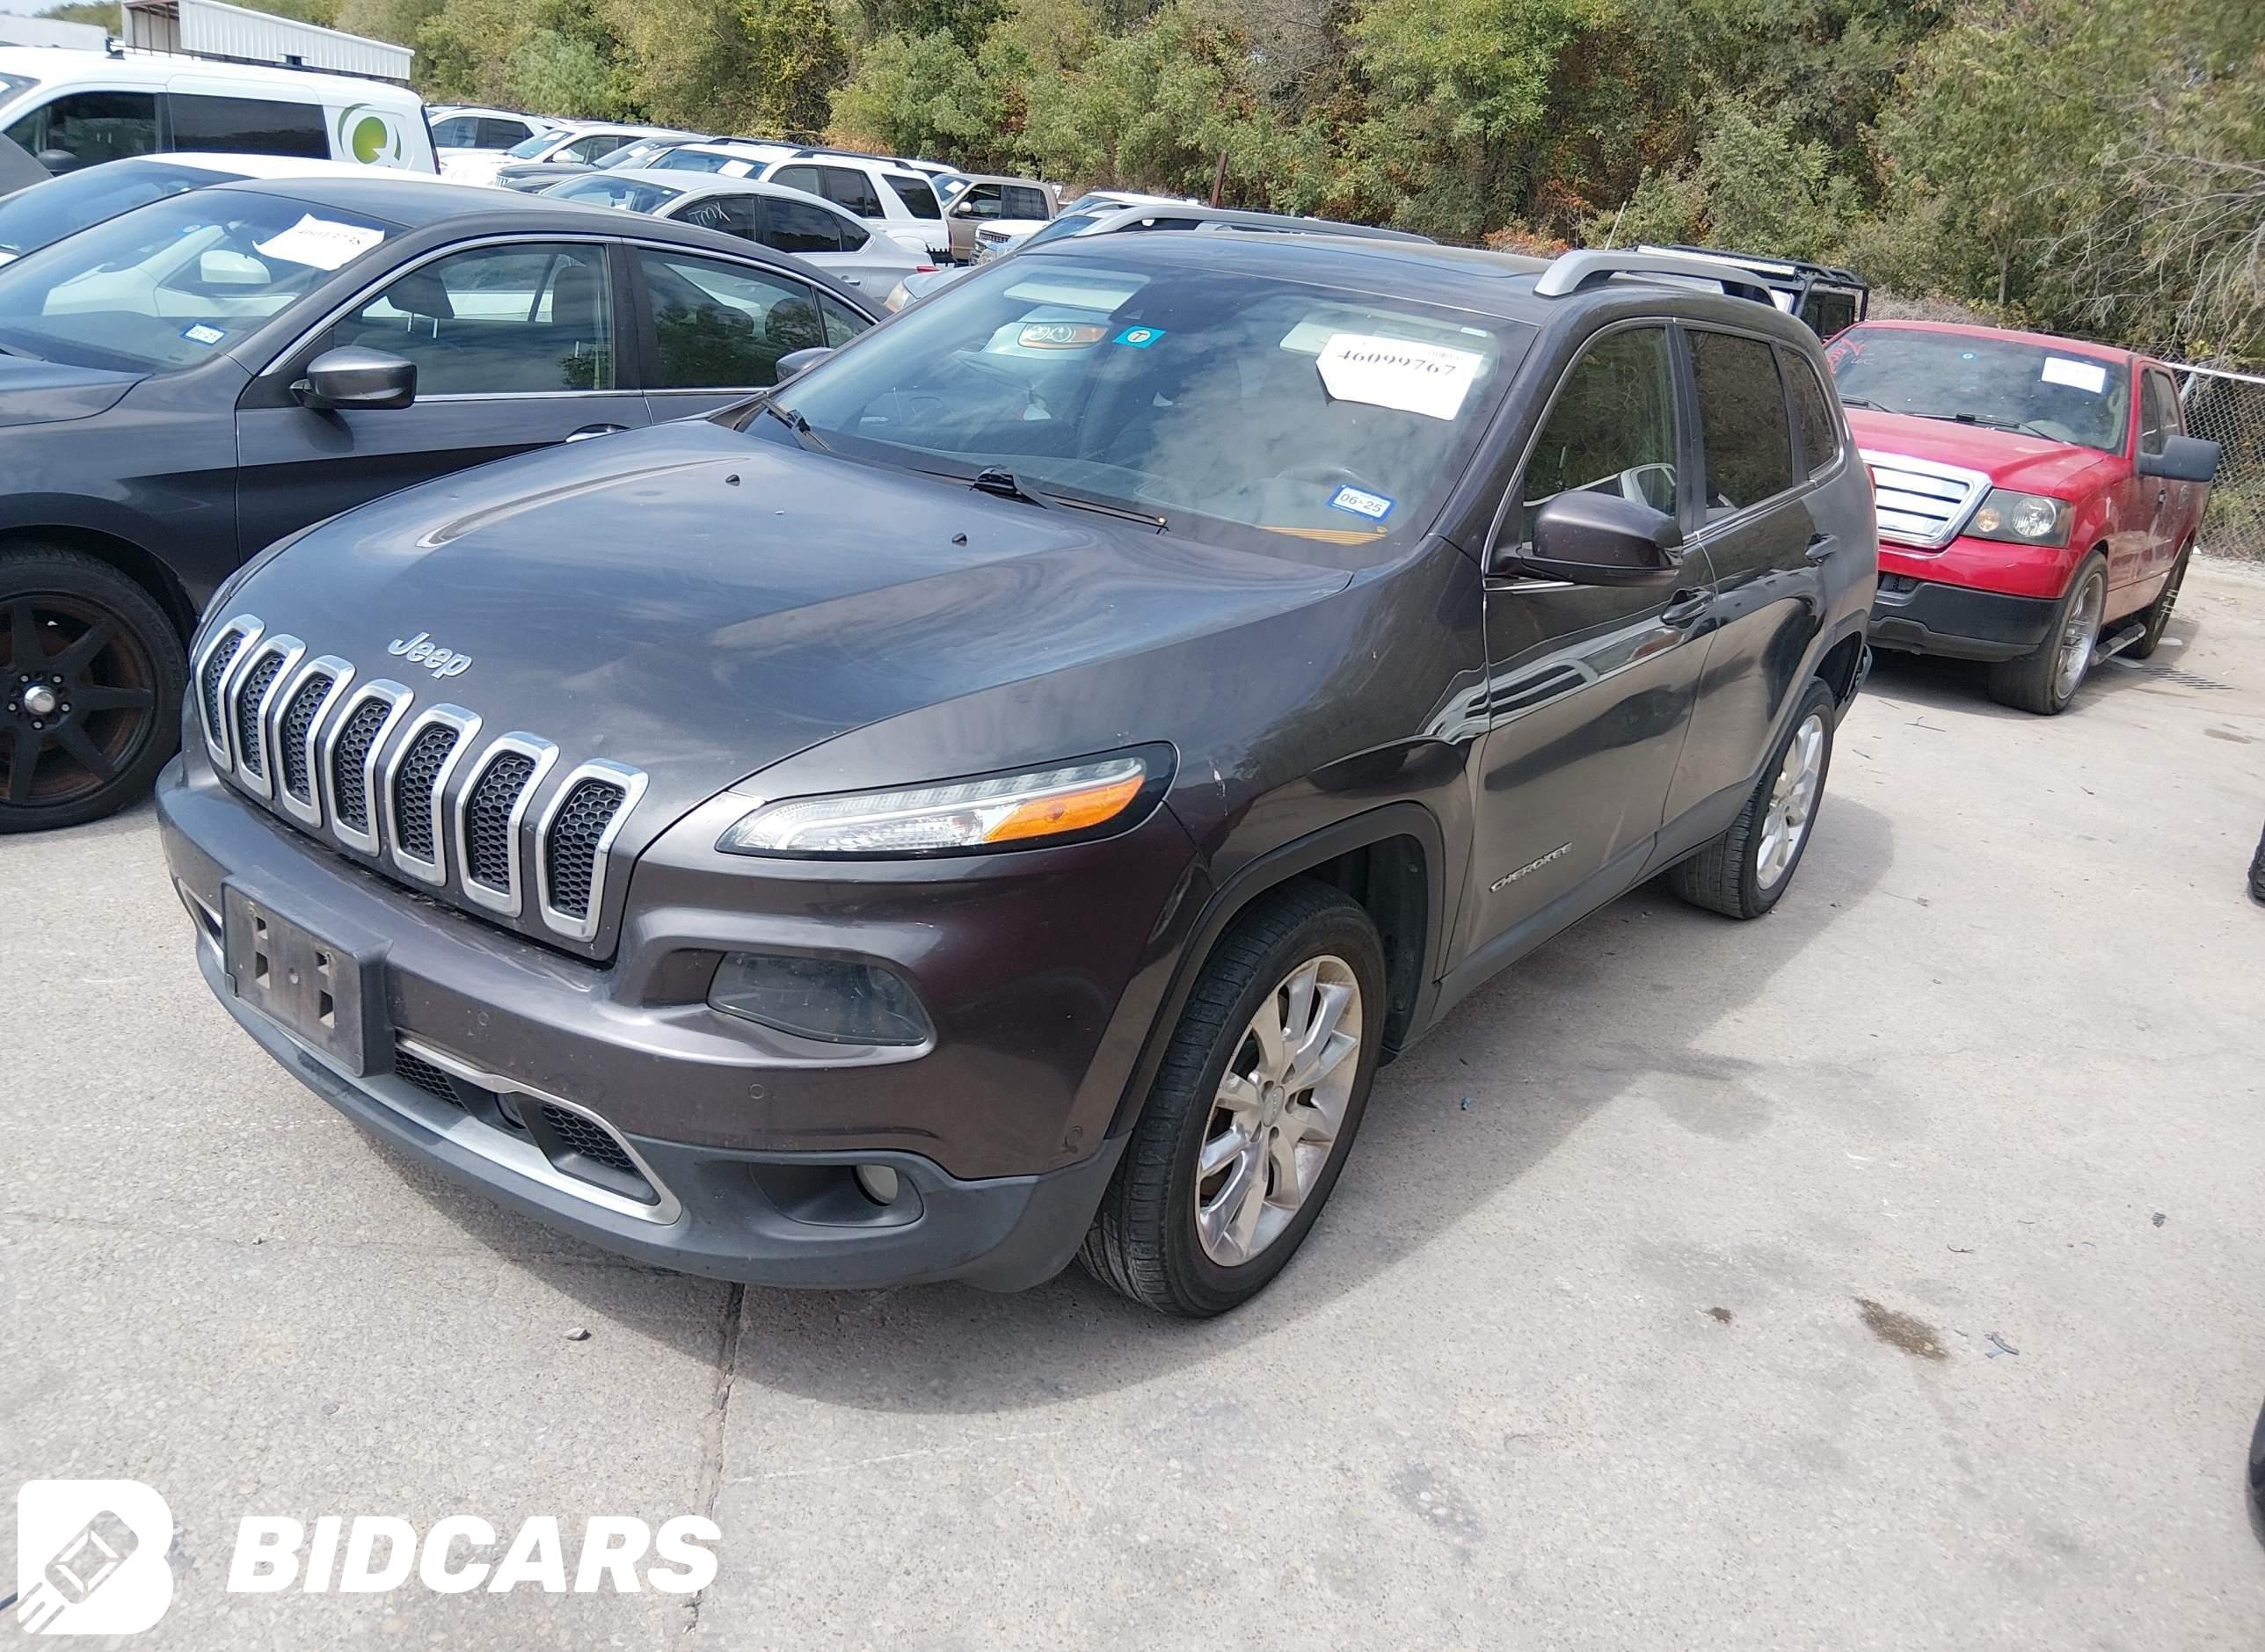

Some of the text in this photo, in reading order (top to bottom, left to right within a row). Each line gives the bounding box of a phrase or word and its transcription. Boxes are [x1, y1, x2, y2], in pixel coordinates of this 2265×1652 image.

[688, 202, 732, 226] TMX
[1336, 350, 1457, 375] 46099767
[387, 631, 472, 680] Jeep
[1489, 841, 1573, 892] CHEROKEE
